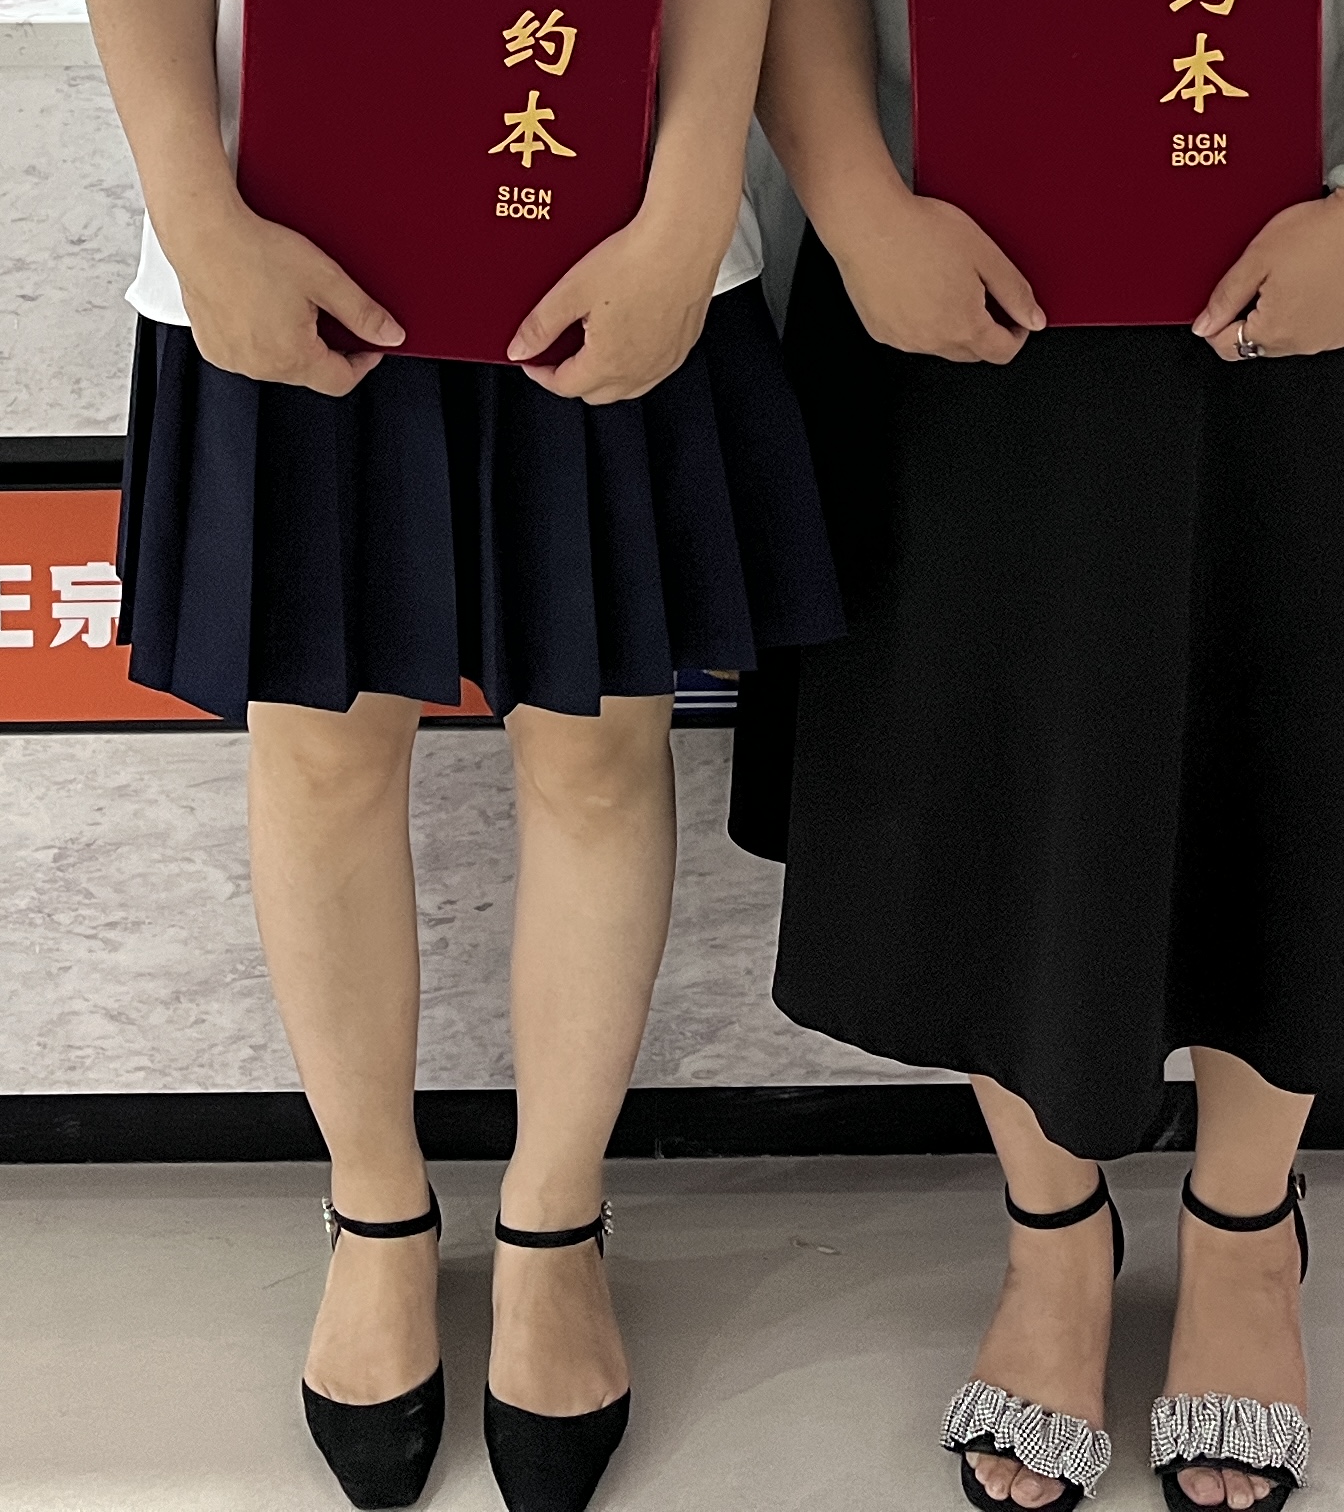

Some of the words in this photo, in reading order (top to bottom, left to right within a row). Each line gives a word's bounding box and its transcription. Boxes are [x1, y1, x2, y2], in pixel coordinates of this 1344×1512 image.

[1172, 133, 1227, 150] SIGN
[1171, 150, 1227, 166] BOOK
[497, 185, 552, 204] SIGN
[495, 202, 551, 220] BOOK
